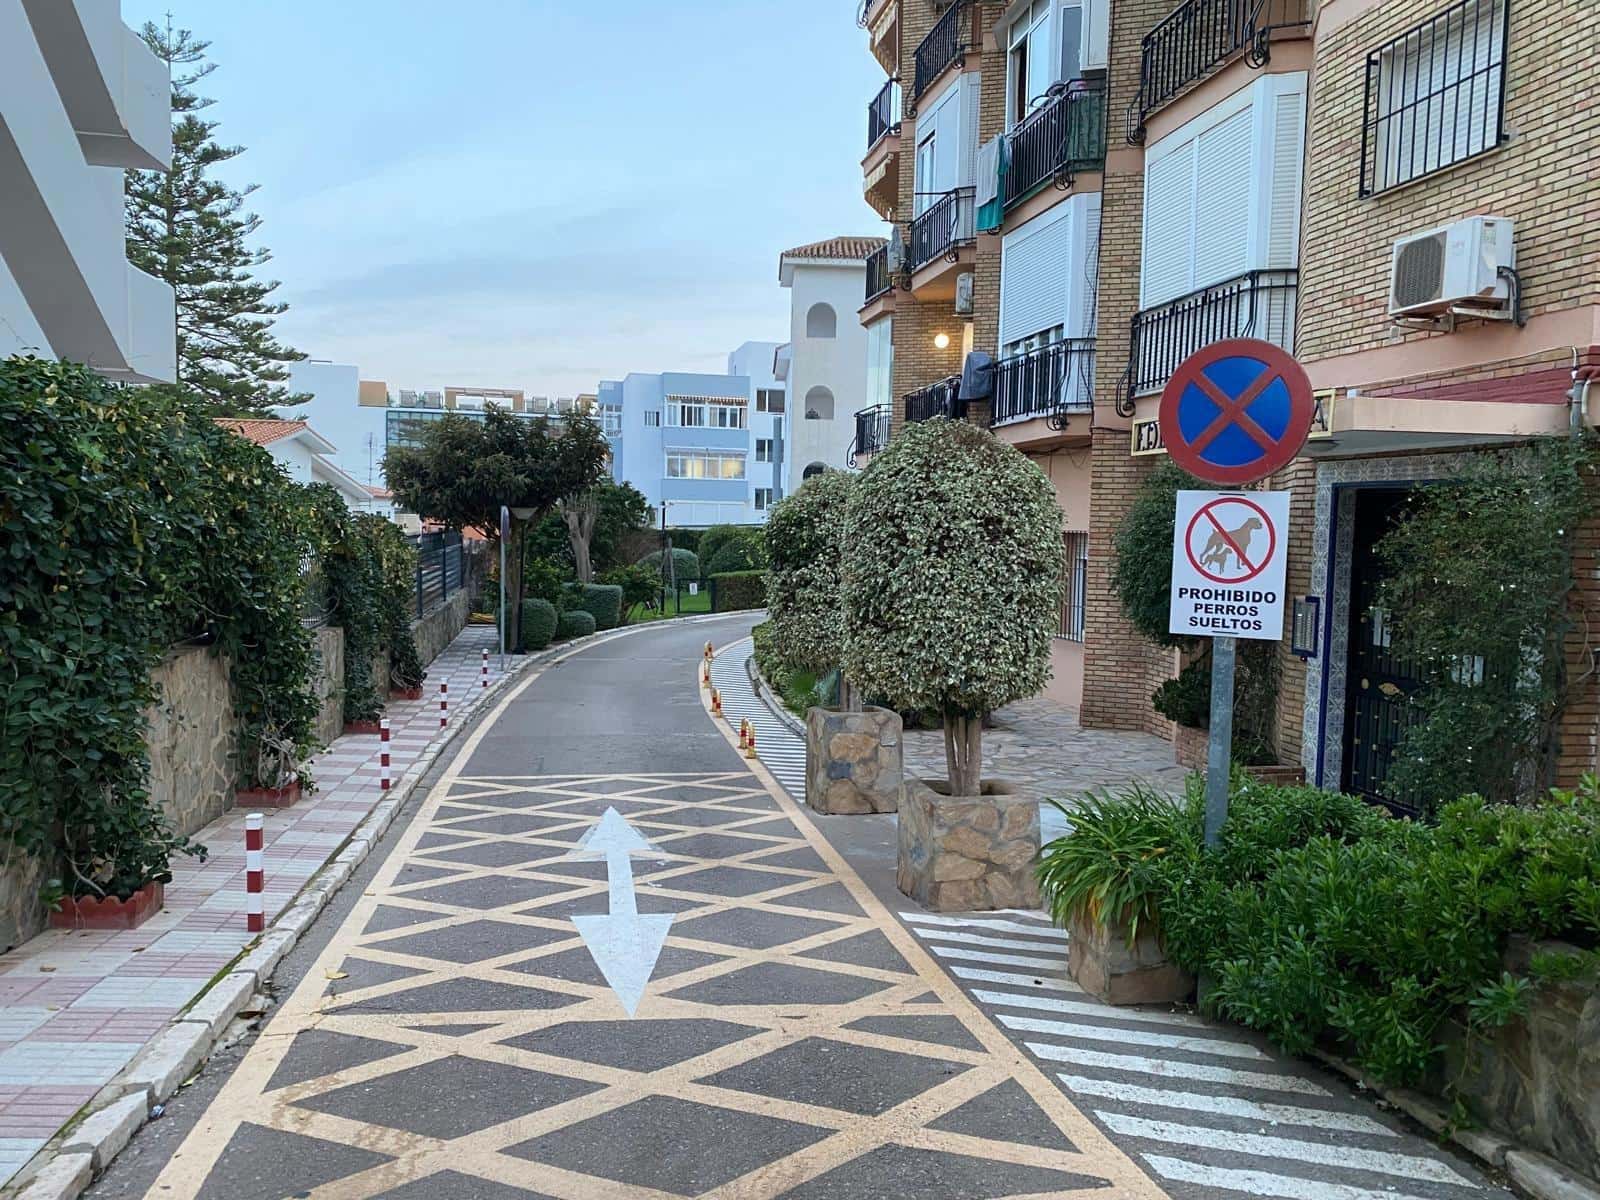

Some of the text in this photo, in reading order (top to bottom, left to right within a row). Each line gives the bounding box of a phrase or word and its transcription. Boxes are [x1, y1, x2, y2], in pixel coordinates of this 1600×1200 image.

[1178, 587, 1277, 604] PROHIBIDO
[1193, 602, 1259, 617] PERROS
[1188, 616, 1263, 631] SUELTOS
